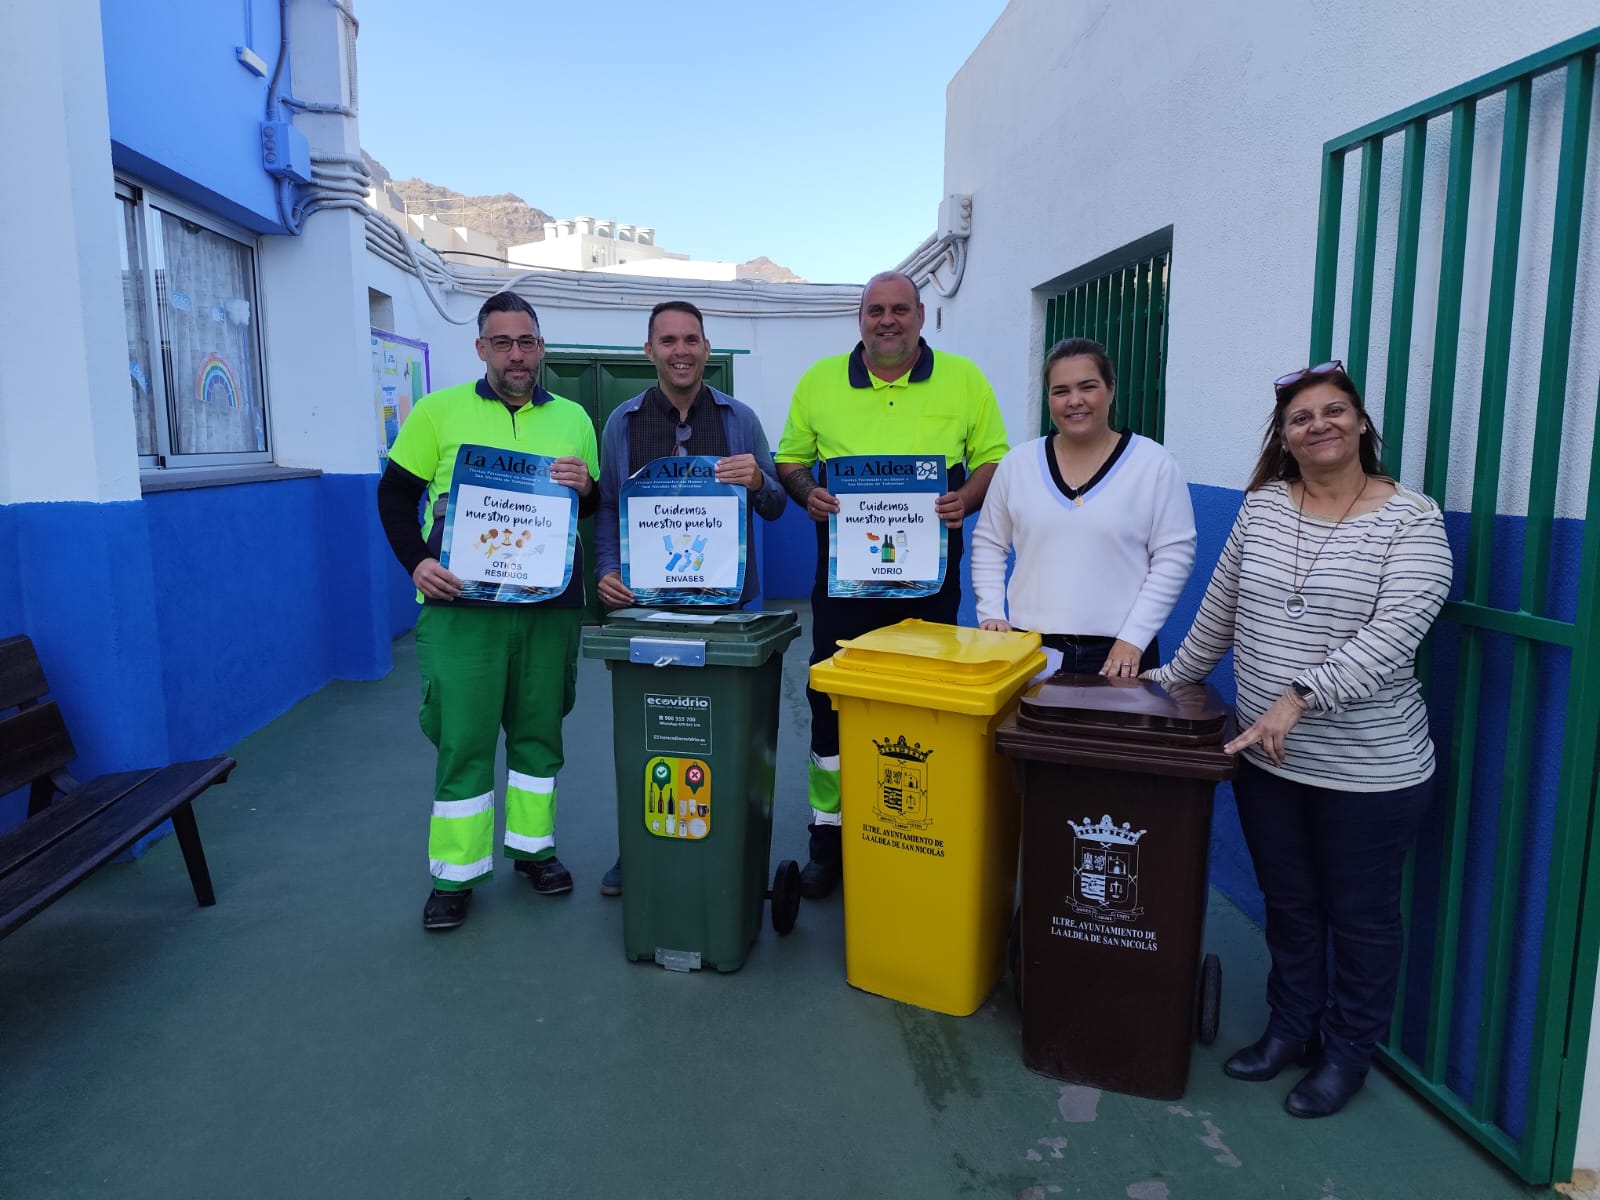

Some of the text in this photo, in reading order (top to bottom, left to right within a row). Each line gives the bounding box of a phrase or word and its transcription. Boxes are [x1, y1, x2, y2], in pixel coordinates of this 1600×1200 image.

[464, 450, 549, 478] La Aldea
[656, 462, 714, 478] Aldea
[834, 461, 914, 476] La Aldea
[484, 496, 536, 513] Cuidemos
[654, 504, 706, 516] Cuidemos
[860, 500, 909, 512] Cuidemos
[466, 509, 552, 528] nuestro pueblo
[639, 518, 722, 531] nuestro pueblo
[846, 513, 924, 526] nuestro pueblo
[492, 561, 522, 570] OTROS
[484, 569, 528, 580] RESIDUOS
[647, 697, 708, 707] ecovidrio
[883, 830, 934, 846] AYUNTAMIENTO
[871, 835, 890, 846] ALDEA
[902, 842, 914, 851] SAN
[916, 846, 944, 857] NICOLÁS
[1078, 921, 1144, 939] AYUNTAMIENTO
[1145, 931, 1156, 940] DE
[1051, 926, 1158, 951] LA ALDEA DE SAN NICOLÁS
